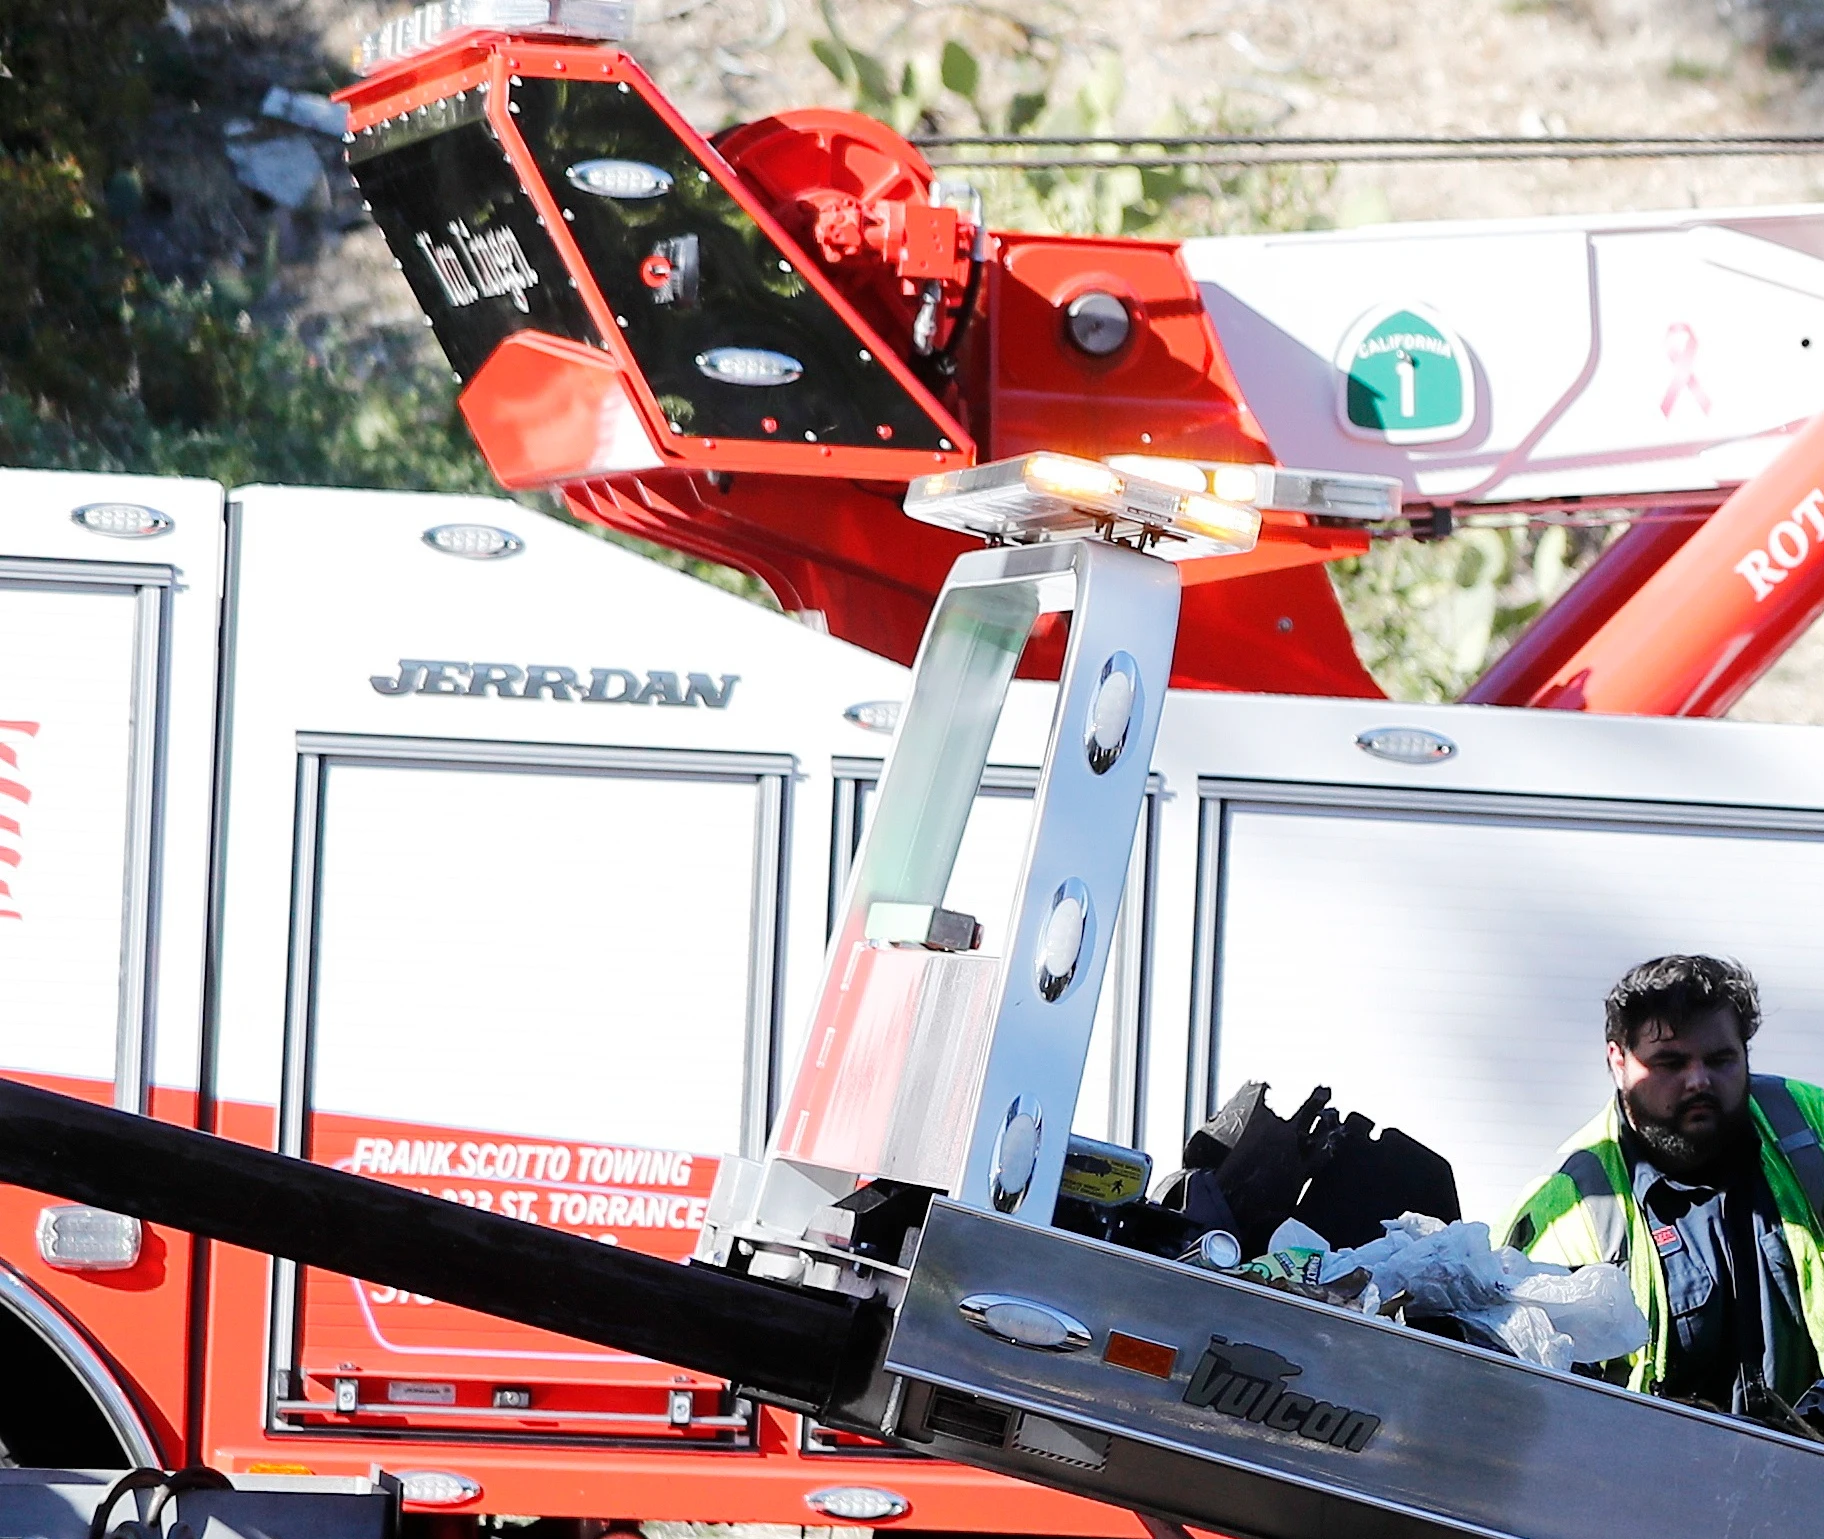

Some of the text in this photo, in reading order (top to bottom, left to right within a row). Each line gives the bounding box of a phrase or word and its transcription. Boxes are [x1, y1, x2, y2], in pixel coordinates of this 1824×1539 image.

[1358, 331, 1454, 360] CALIFORNIA
[1395, 361, 1416, 419] 1
[352, 1136, 694, 1188] FRANK SCOTTO TOWING
[547, 1192, 708, 1231] TORRANCE
[1182, 1348, 1381, 1453] Vulcan
